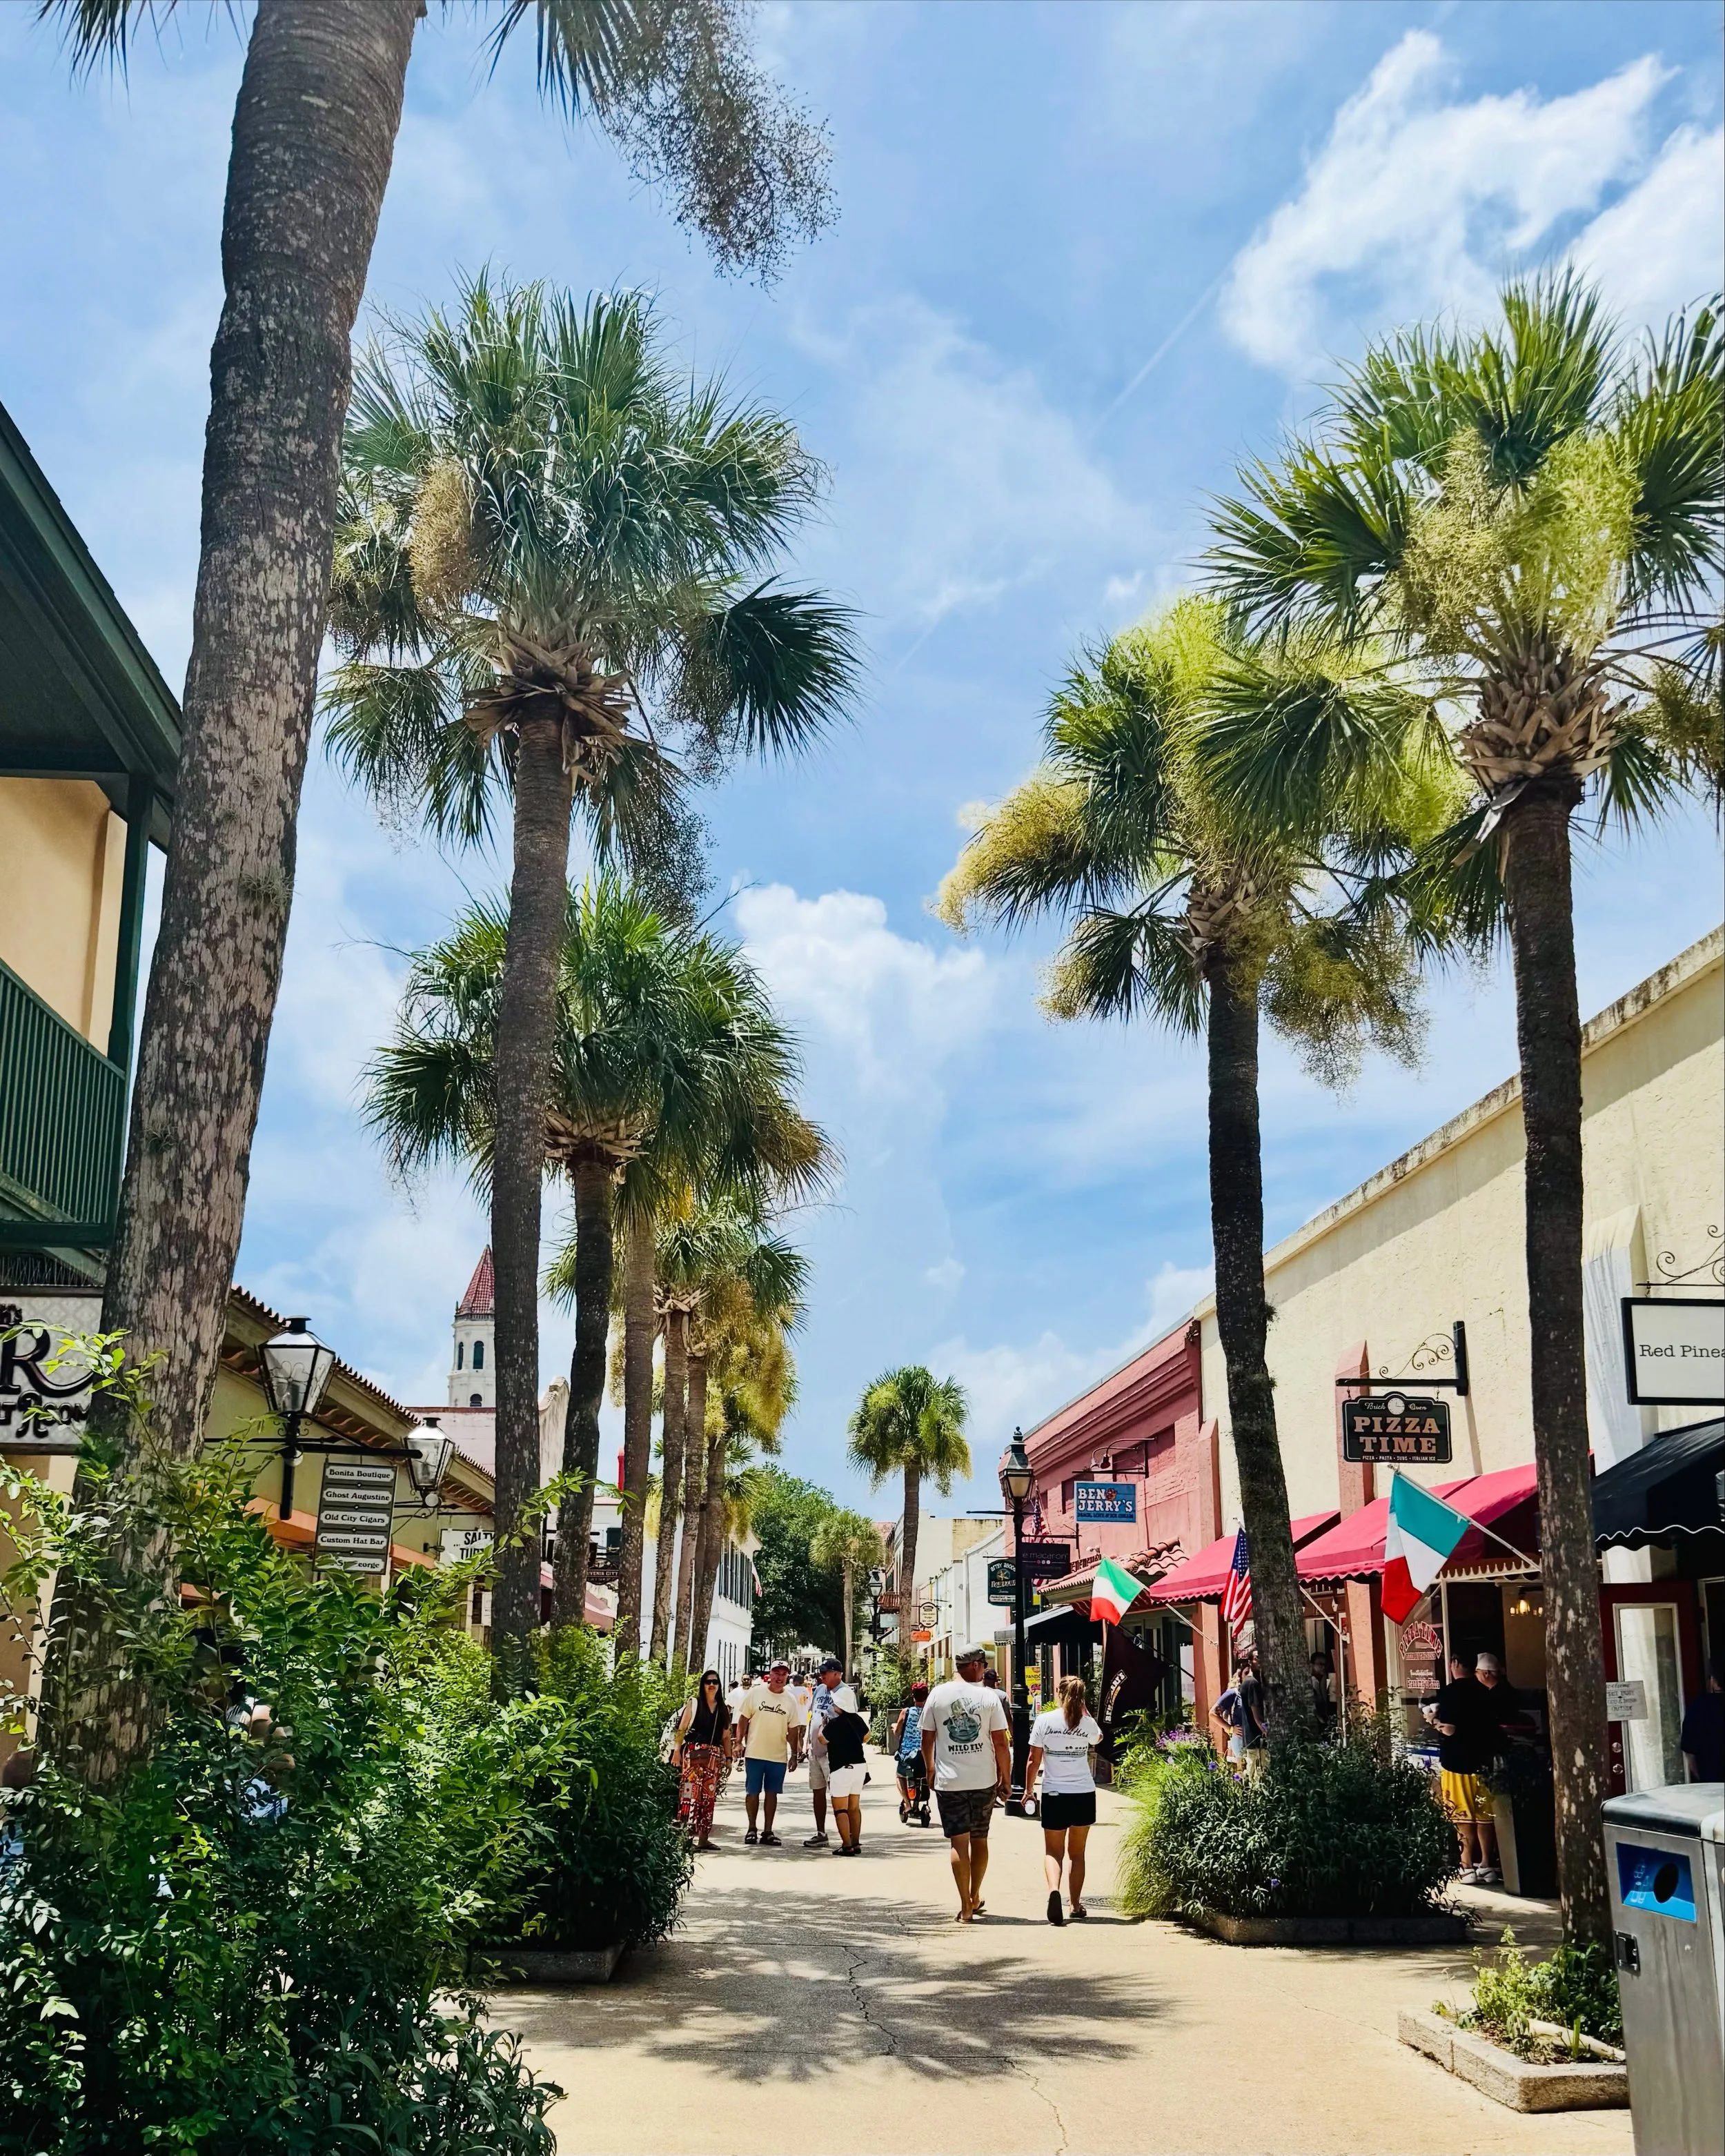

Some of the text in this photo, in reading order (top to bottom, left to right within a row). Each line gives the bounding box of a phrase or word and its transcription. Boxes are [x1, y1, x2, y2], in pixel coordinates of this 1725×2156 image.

[1639, 1344, 1675, 1357] Red
[1364, 1402, 1386, 1410] Brick
[1353, 1416, 1441, 1434] PIZZA
[1359, 1436, 1437, 1454] TIME
[357, 1470, 391, 1478] Boutique
[325, 1490, 390, 1501] Ghost Augustine
[1078, 1488, 1105, 1499] BEN
[1078, 1500, 1133, 1512] JERRY'S
[341, 1514, 357, 1523] City
[359, 1515, 385, 1523] Cigars
[320, 1536, 351, 1544] Custom
[970, 1742, 983, 1750] FLY
